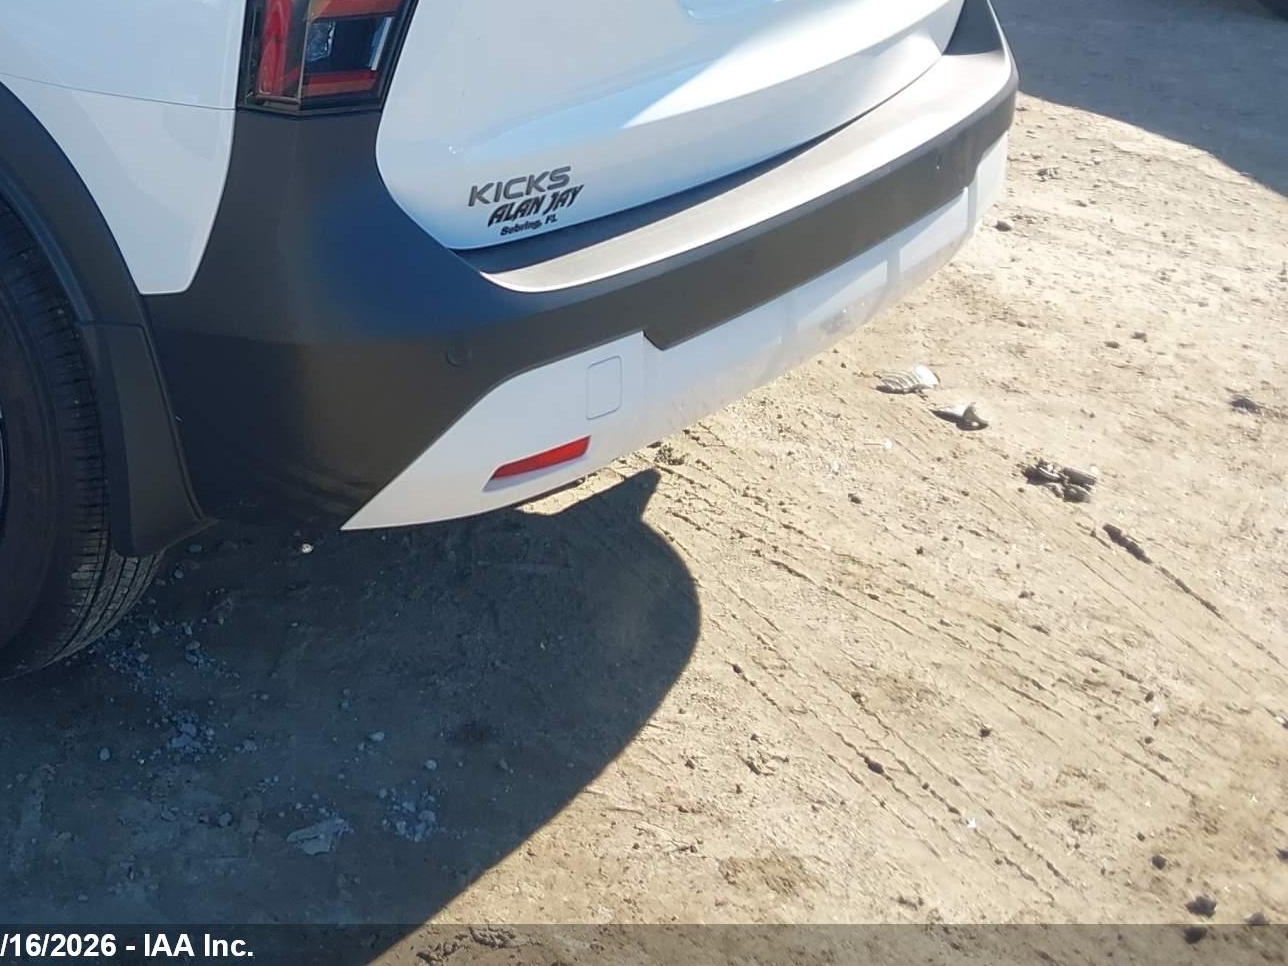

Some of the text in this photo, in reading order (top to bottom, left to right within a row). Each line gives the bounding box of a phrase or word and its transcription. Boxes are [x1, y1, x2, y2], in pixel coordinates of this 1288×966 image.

[468, 165, 571, 207] KICKS
[487, 184, 585, 227] ALAN JAY
